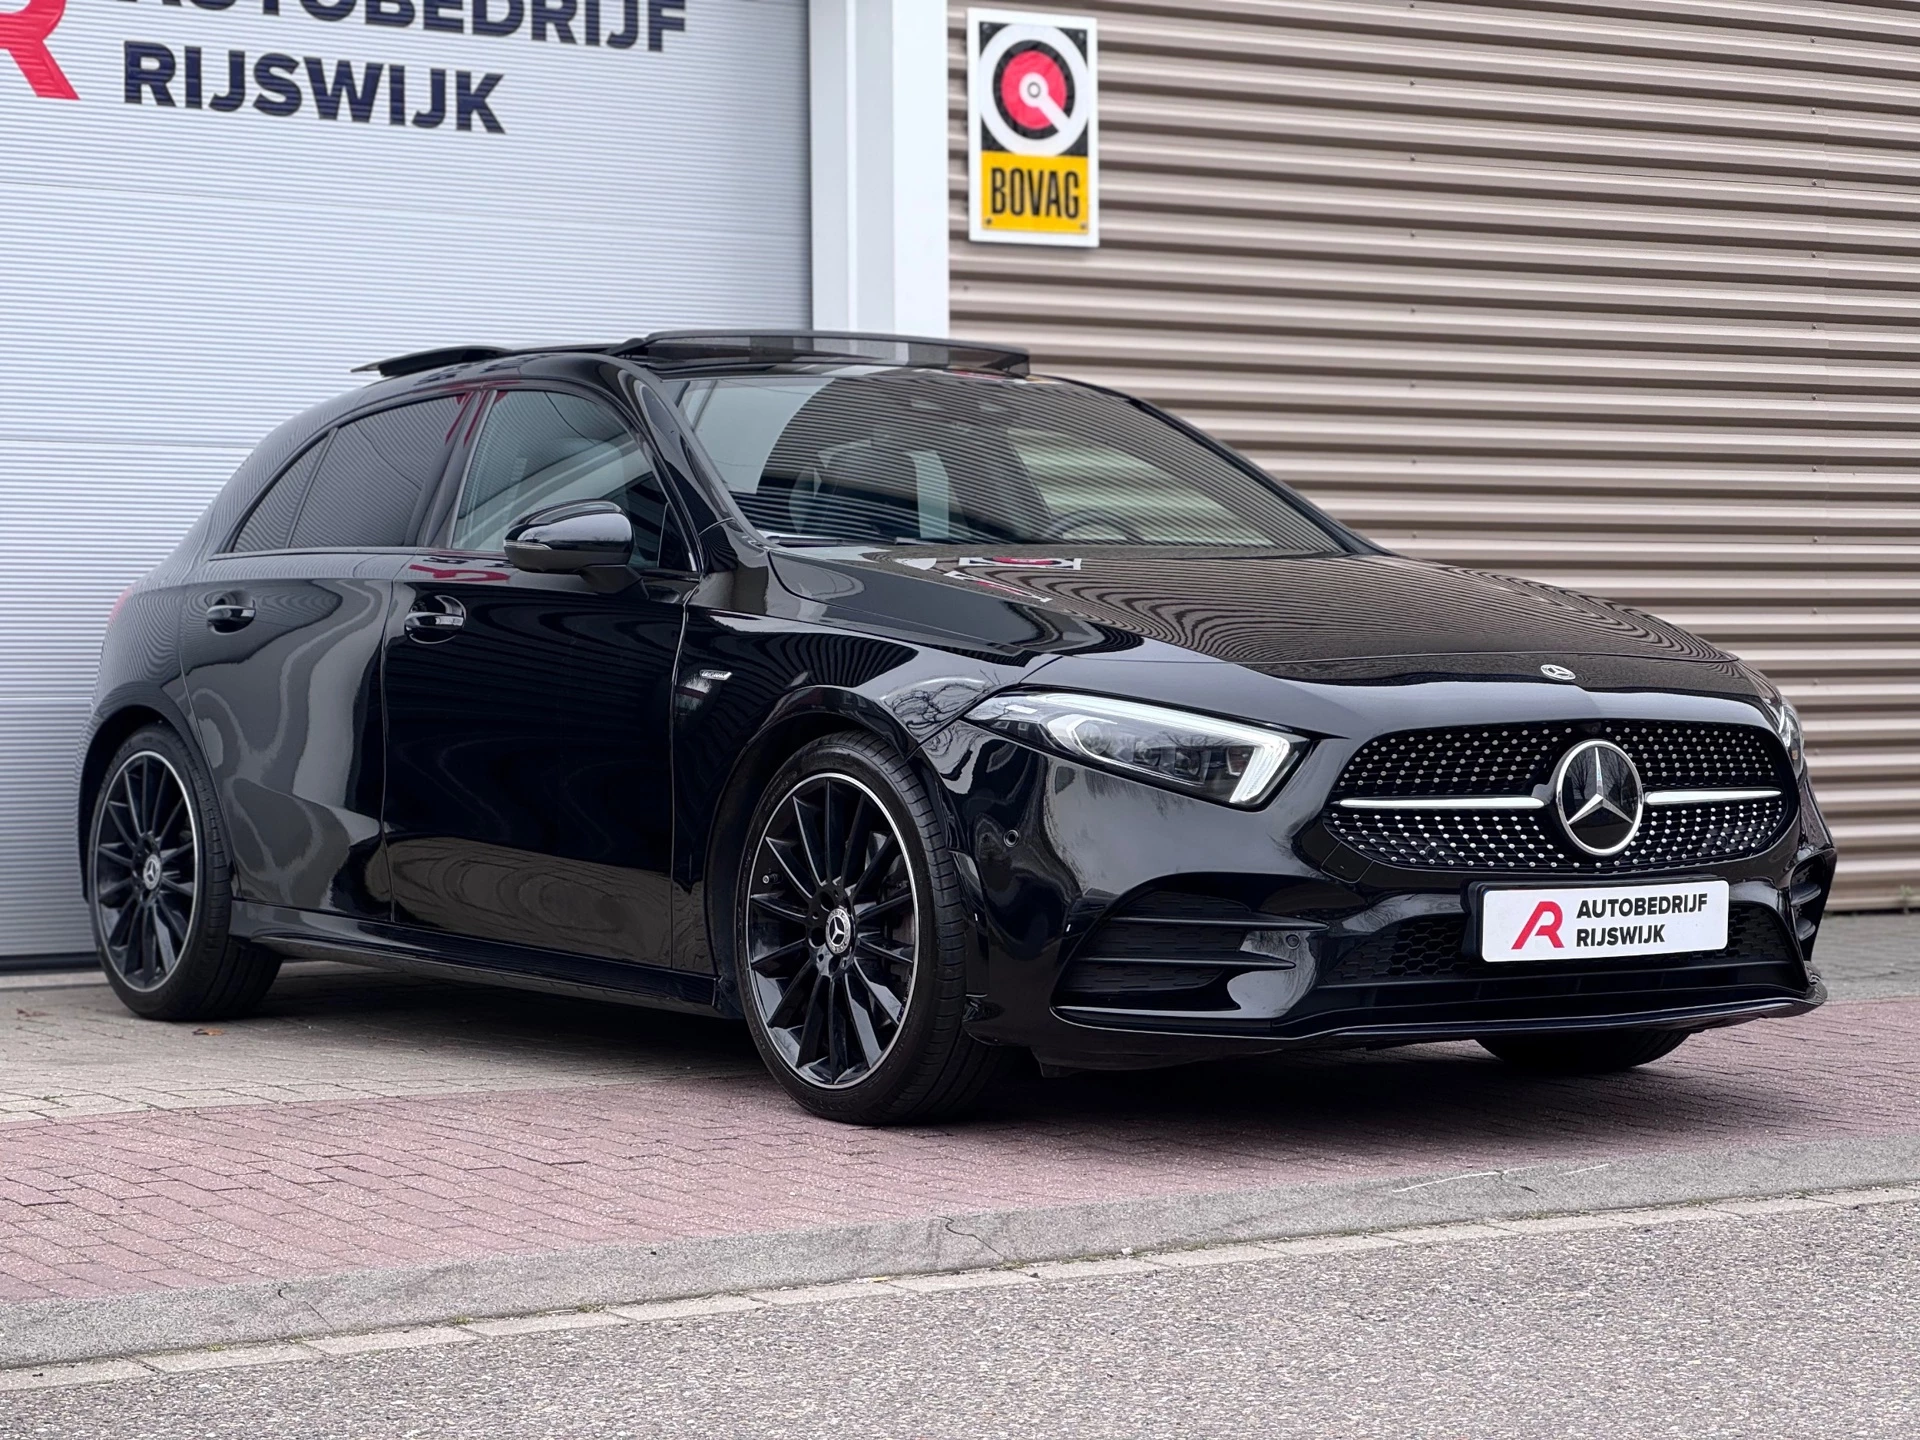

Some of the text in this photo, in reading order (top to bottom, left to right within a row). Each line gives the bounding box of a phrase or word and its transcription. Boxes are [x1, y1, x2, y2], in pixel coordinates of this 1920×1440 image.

[124, 40, 506, 135] RIJSWIJK
[991, 167, 1079, 219] BOVAG
[1576, 893, 1708, 919] AUTOBEDRIJF
[1576, 924, 1666, 948] RIJSWIJK
